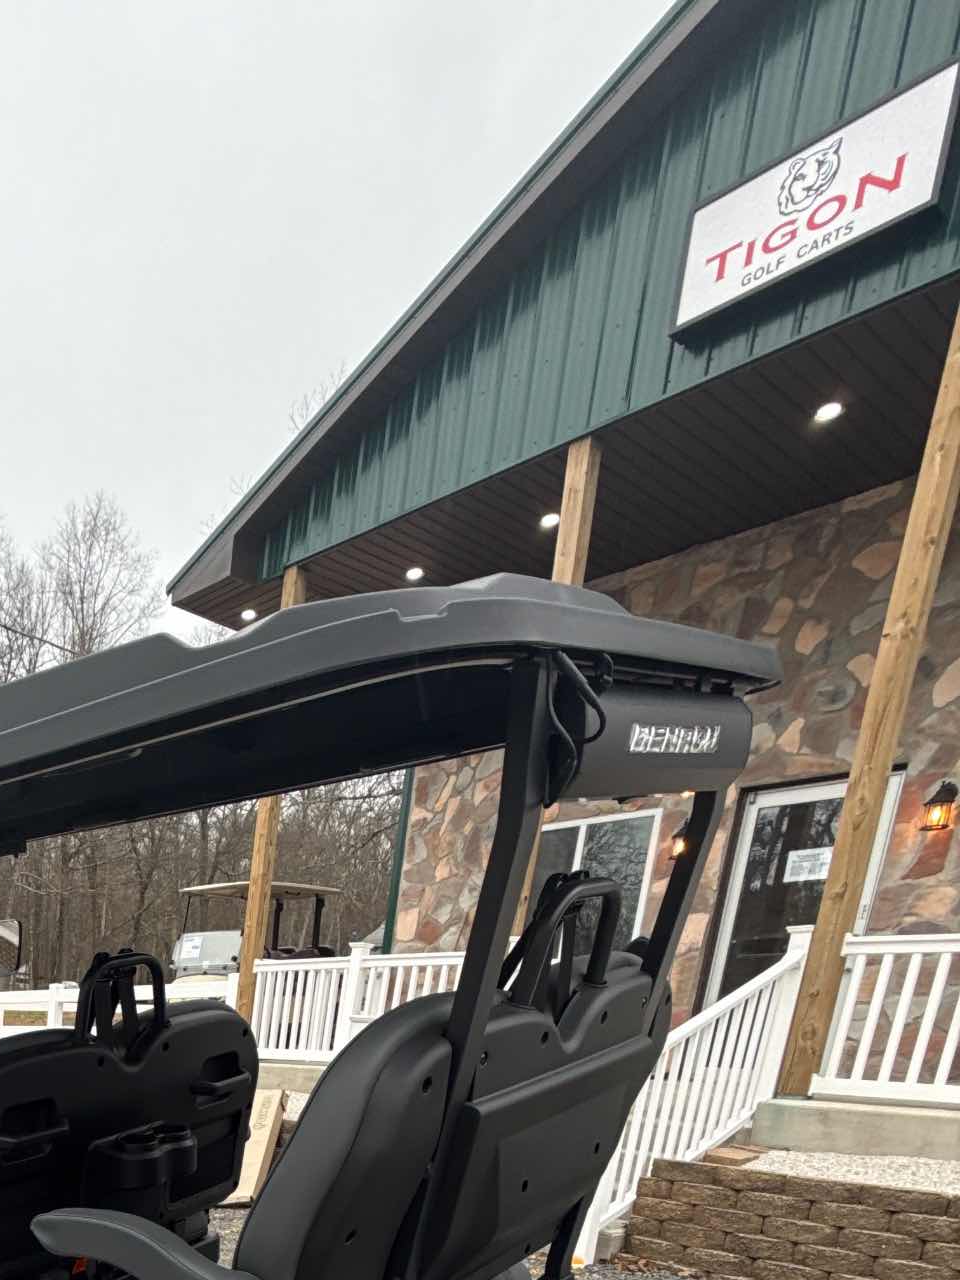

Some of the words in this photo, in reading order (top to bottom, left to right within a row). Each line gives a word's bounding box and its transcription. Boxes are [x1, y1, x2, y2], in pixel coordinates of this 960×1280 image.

[705, 153, 907, 282] TIGON
[741, 256, 786, 287] GOLF
[796, 220, 855, 259] CARTS
